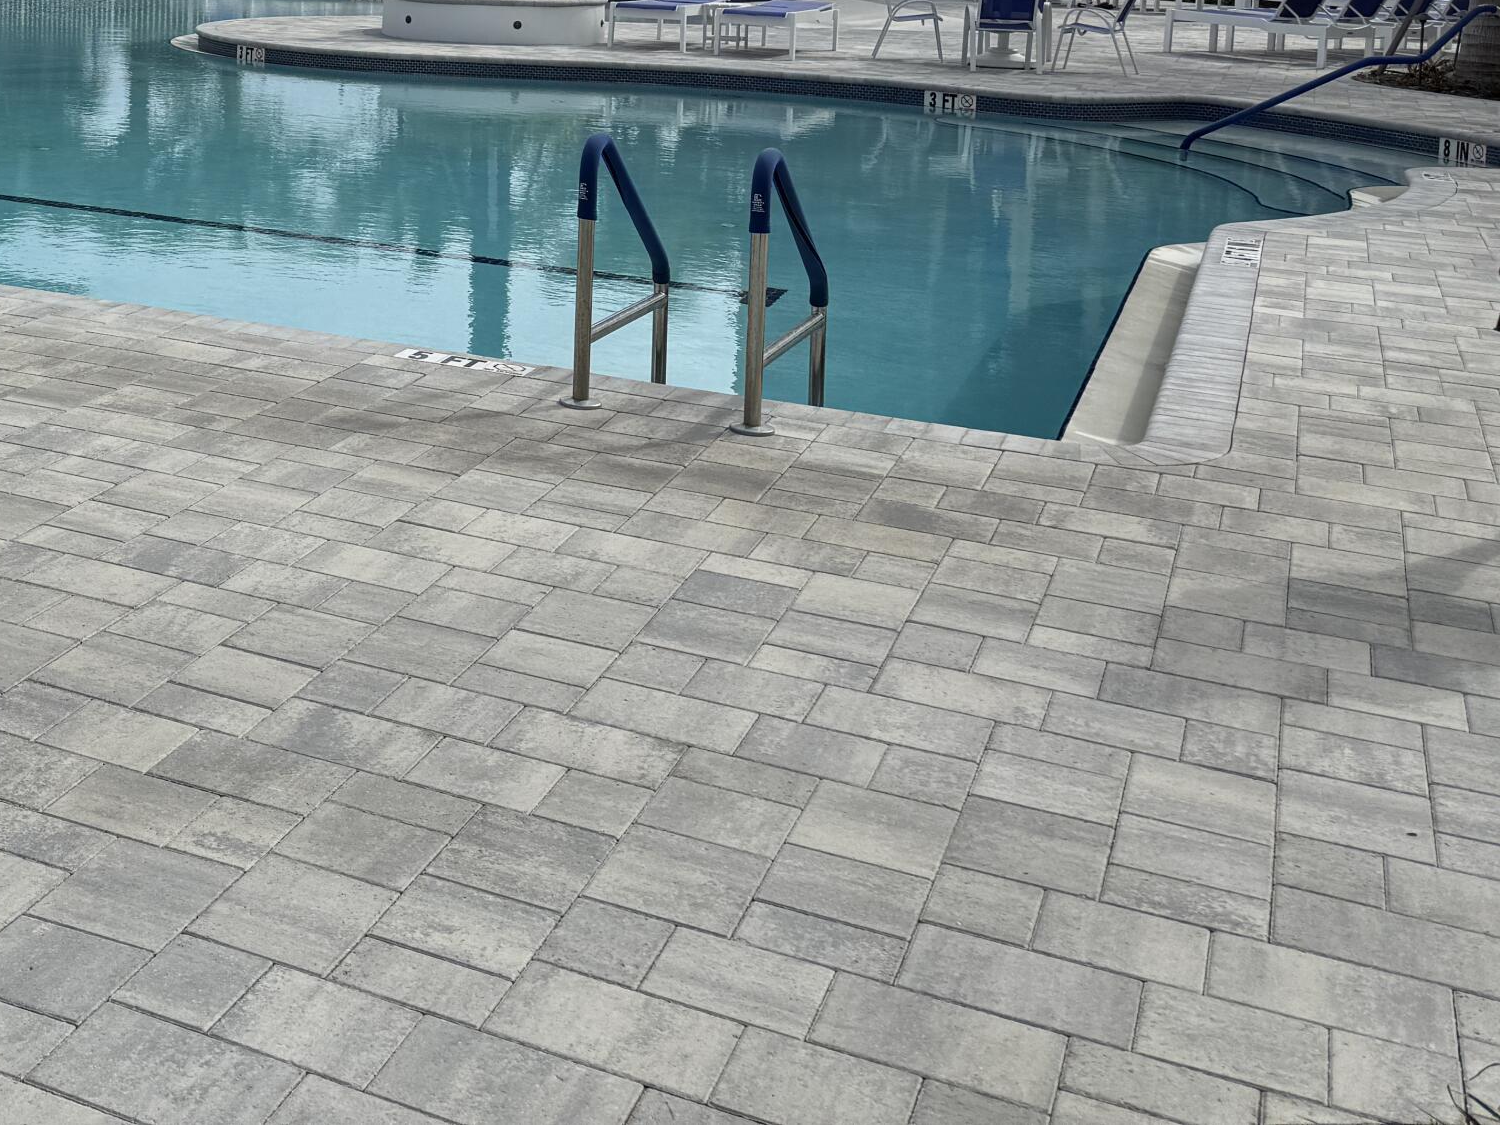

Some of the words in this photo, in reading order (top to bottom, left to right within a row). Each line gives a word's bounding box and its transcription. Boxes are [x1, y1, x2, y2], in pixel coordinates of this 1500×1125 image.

[245, 47, 255, 61] FT
[929, 91, 937, 108] 3
[942, 93, 958, 110] FT
[1443, 139, 1451, 158] 8
[1456, 140, 1469, 162] IN
[408, 350, 434, 361] 5
[441, 355, 488, 368] FT
